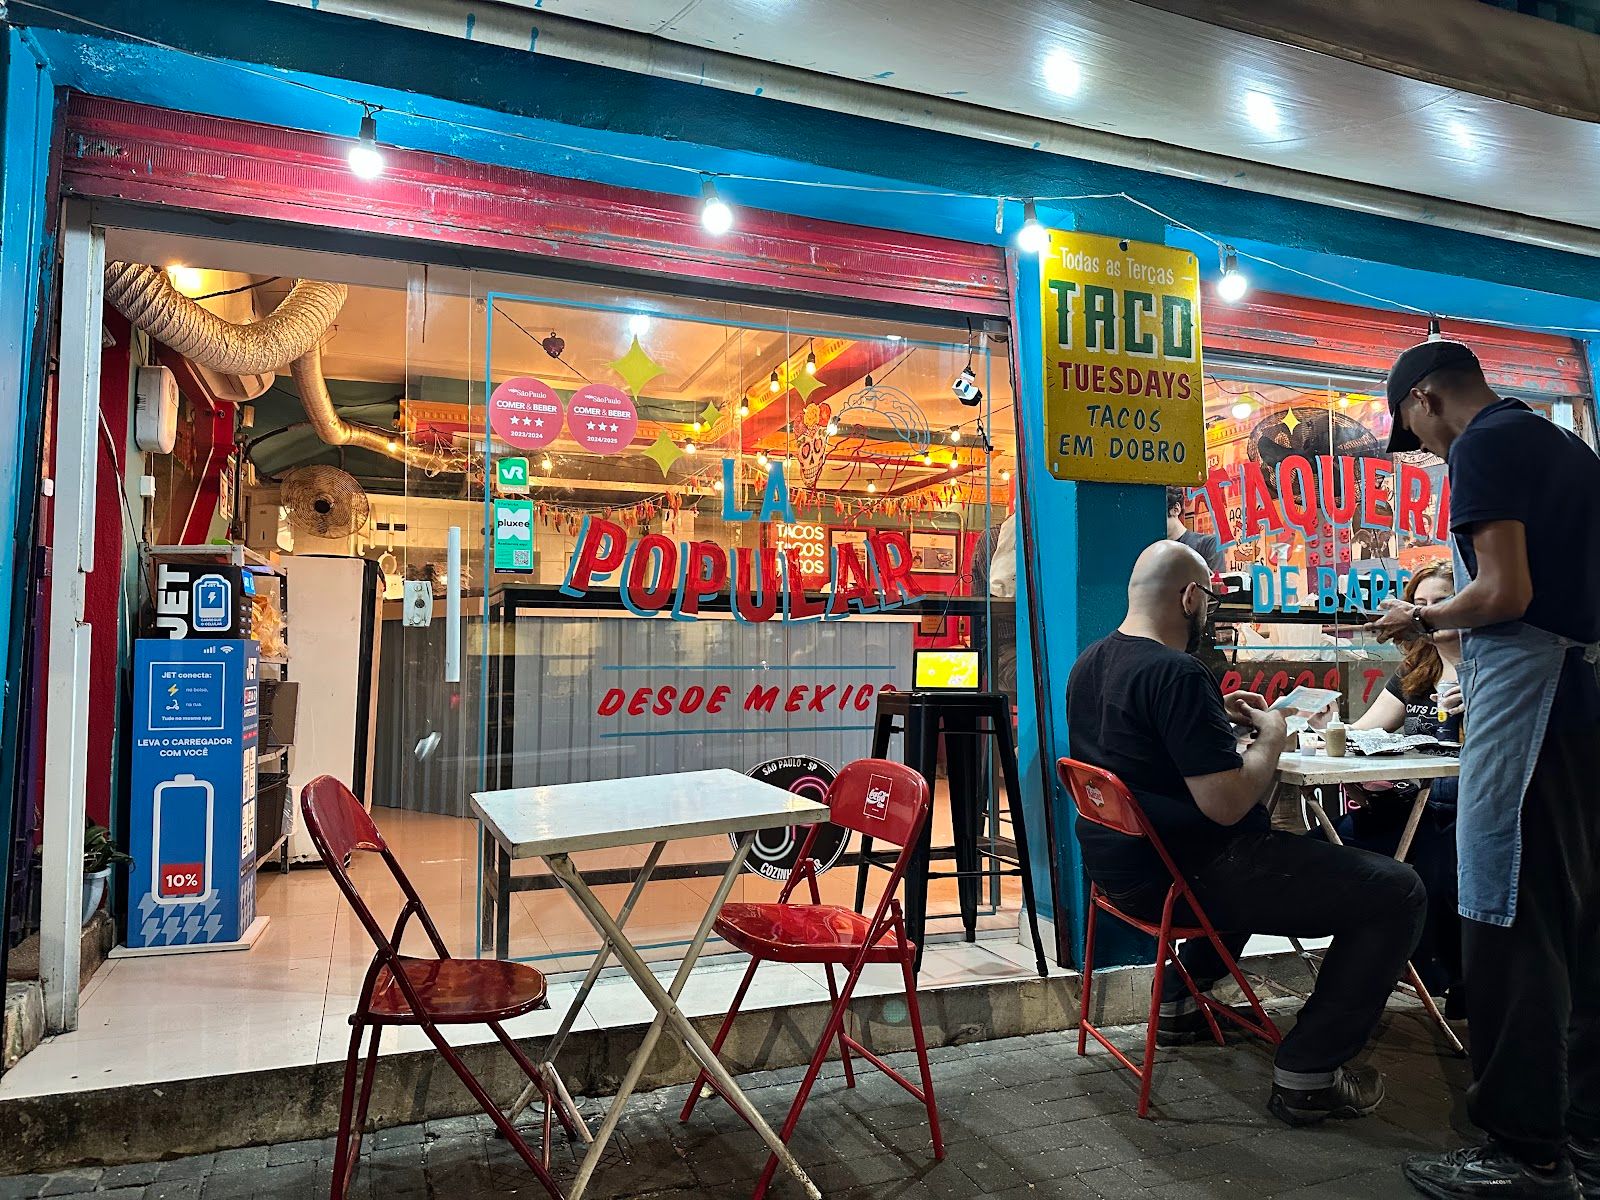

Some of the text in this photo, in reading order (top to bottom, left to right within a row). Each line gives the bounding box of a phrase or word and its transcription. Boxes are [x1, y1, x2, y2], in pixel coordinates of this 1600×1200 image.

[1059, 247, 1175, 285] Todas as Terças
[1049, 278, 1197, 363] TACO
[1058, 361, 1192, 400] TUESDAYS
[496, 400, 558, 413] COMER & BEBER
[573, 406, 601, 416] COMER
[607, 409, 632, 419] BEBER
[1086, 404, 1162, 434] TACOS
[510, 430, 543, 439] 2023/2024
[586, 435, 618, 444] 2024/2025
[1058, 434, 1094, 459] EM
[1108, 437, 1187, 465] DOBRO
[721, 458, 798, 522] LA
[497, 518, 530, 529] pluxee
[776, 523, 825, 541] TACOS
[559, 515, 926, 627] POPULAR
[1252, 565, 1300, 614] DE
[157, 563, 190, 640] JET
[597, 685, 732, 716] DESDE
[1406, 703, 1428, 715] CATS
[137, 738, 233, 747] LEVA O CARREGADOR
[160, 747, 209, 757] COM VOCÊ
[762, 764, 778, 776] SÃO
[778, 757, 802, 768] PAULO
[807, 761, 818, 773] SP
[165, 873, 198, 888] 10%
[760, 861, 794, 881] COZINH
